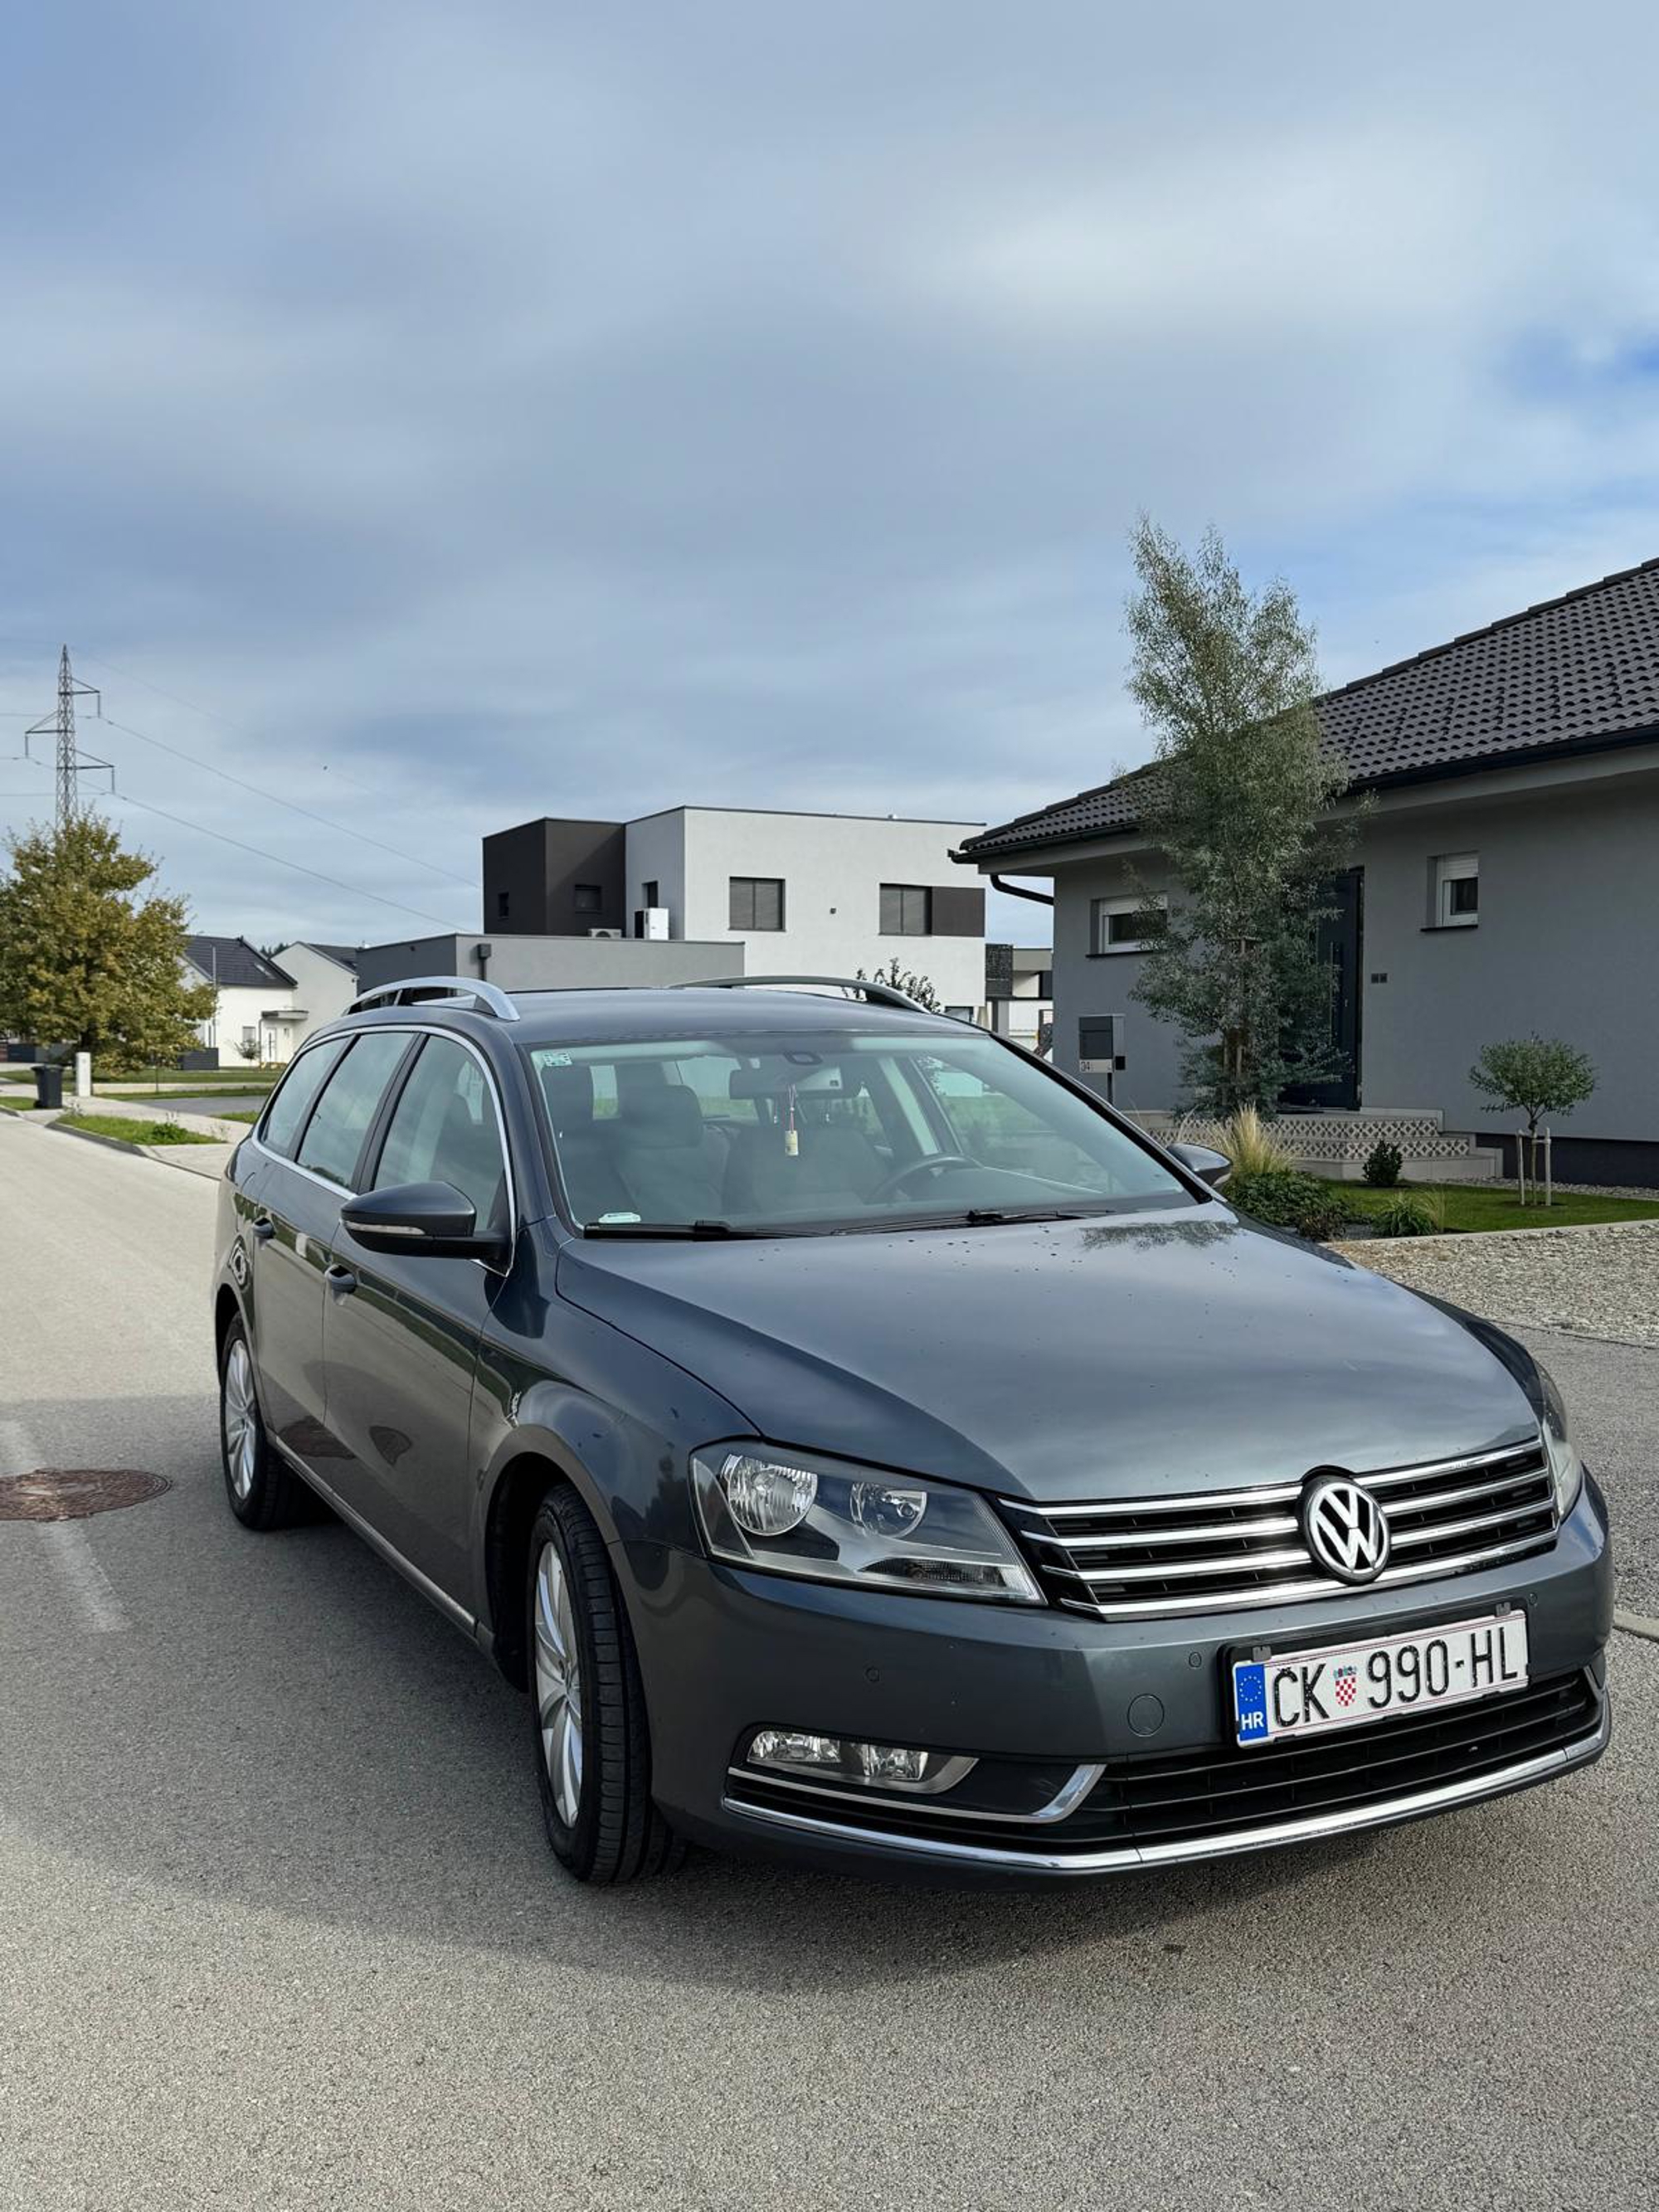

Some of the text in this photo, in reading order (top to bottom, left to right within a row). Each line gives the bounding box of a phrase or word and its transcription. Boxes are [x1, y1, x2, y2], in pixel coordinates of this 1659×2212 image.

[1311, 1484, 1385, 1573] VW
[1368, 1626, 1519, 1709] 990-HL
[1241, 1710, 1265, 1731] HR
